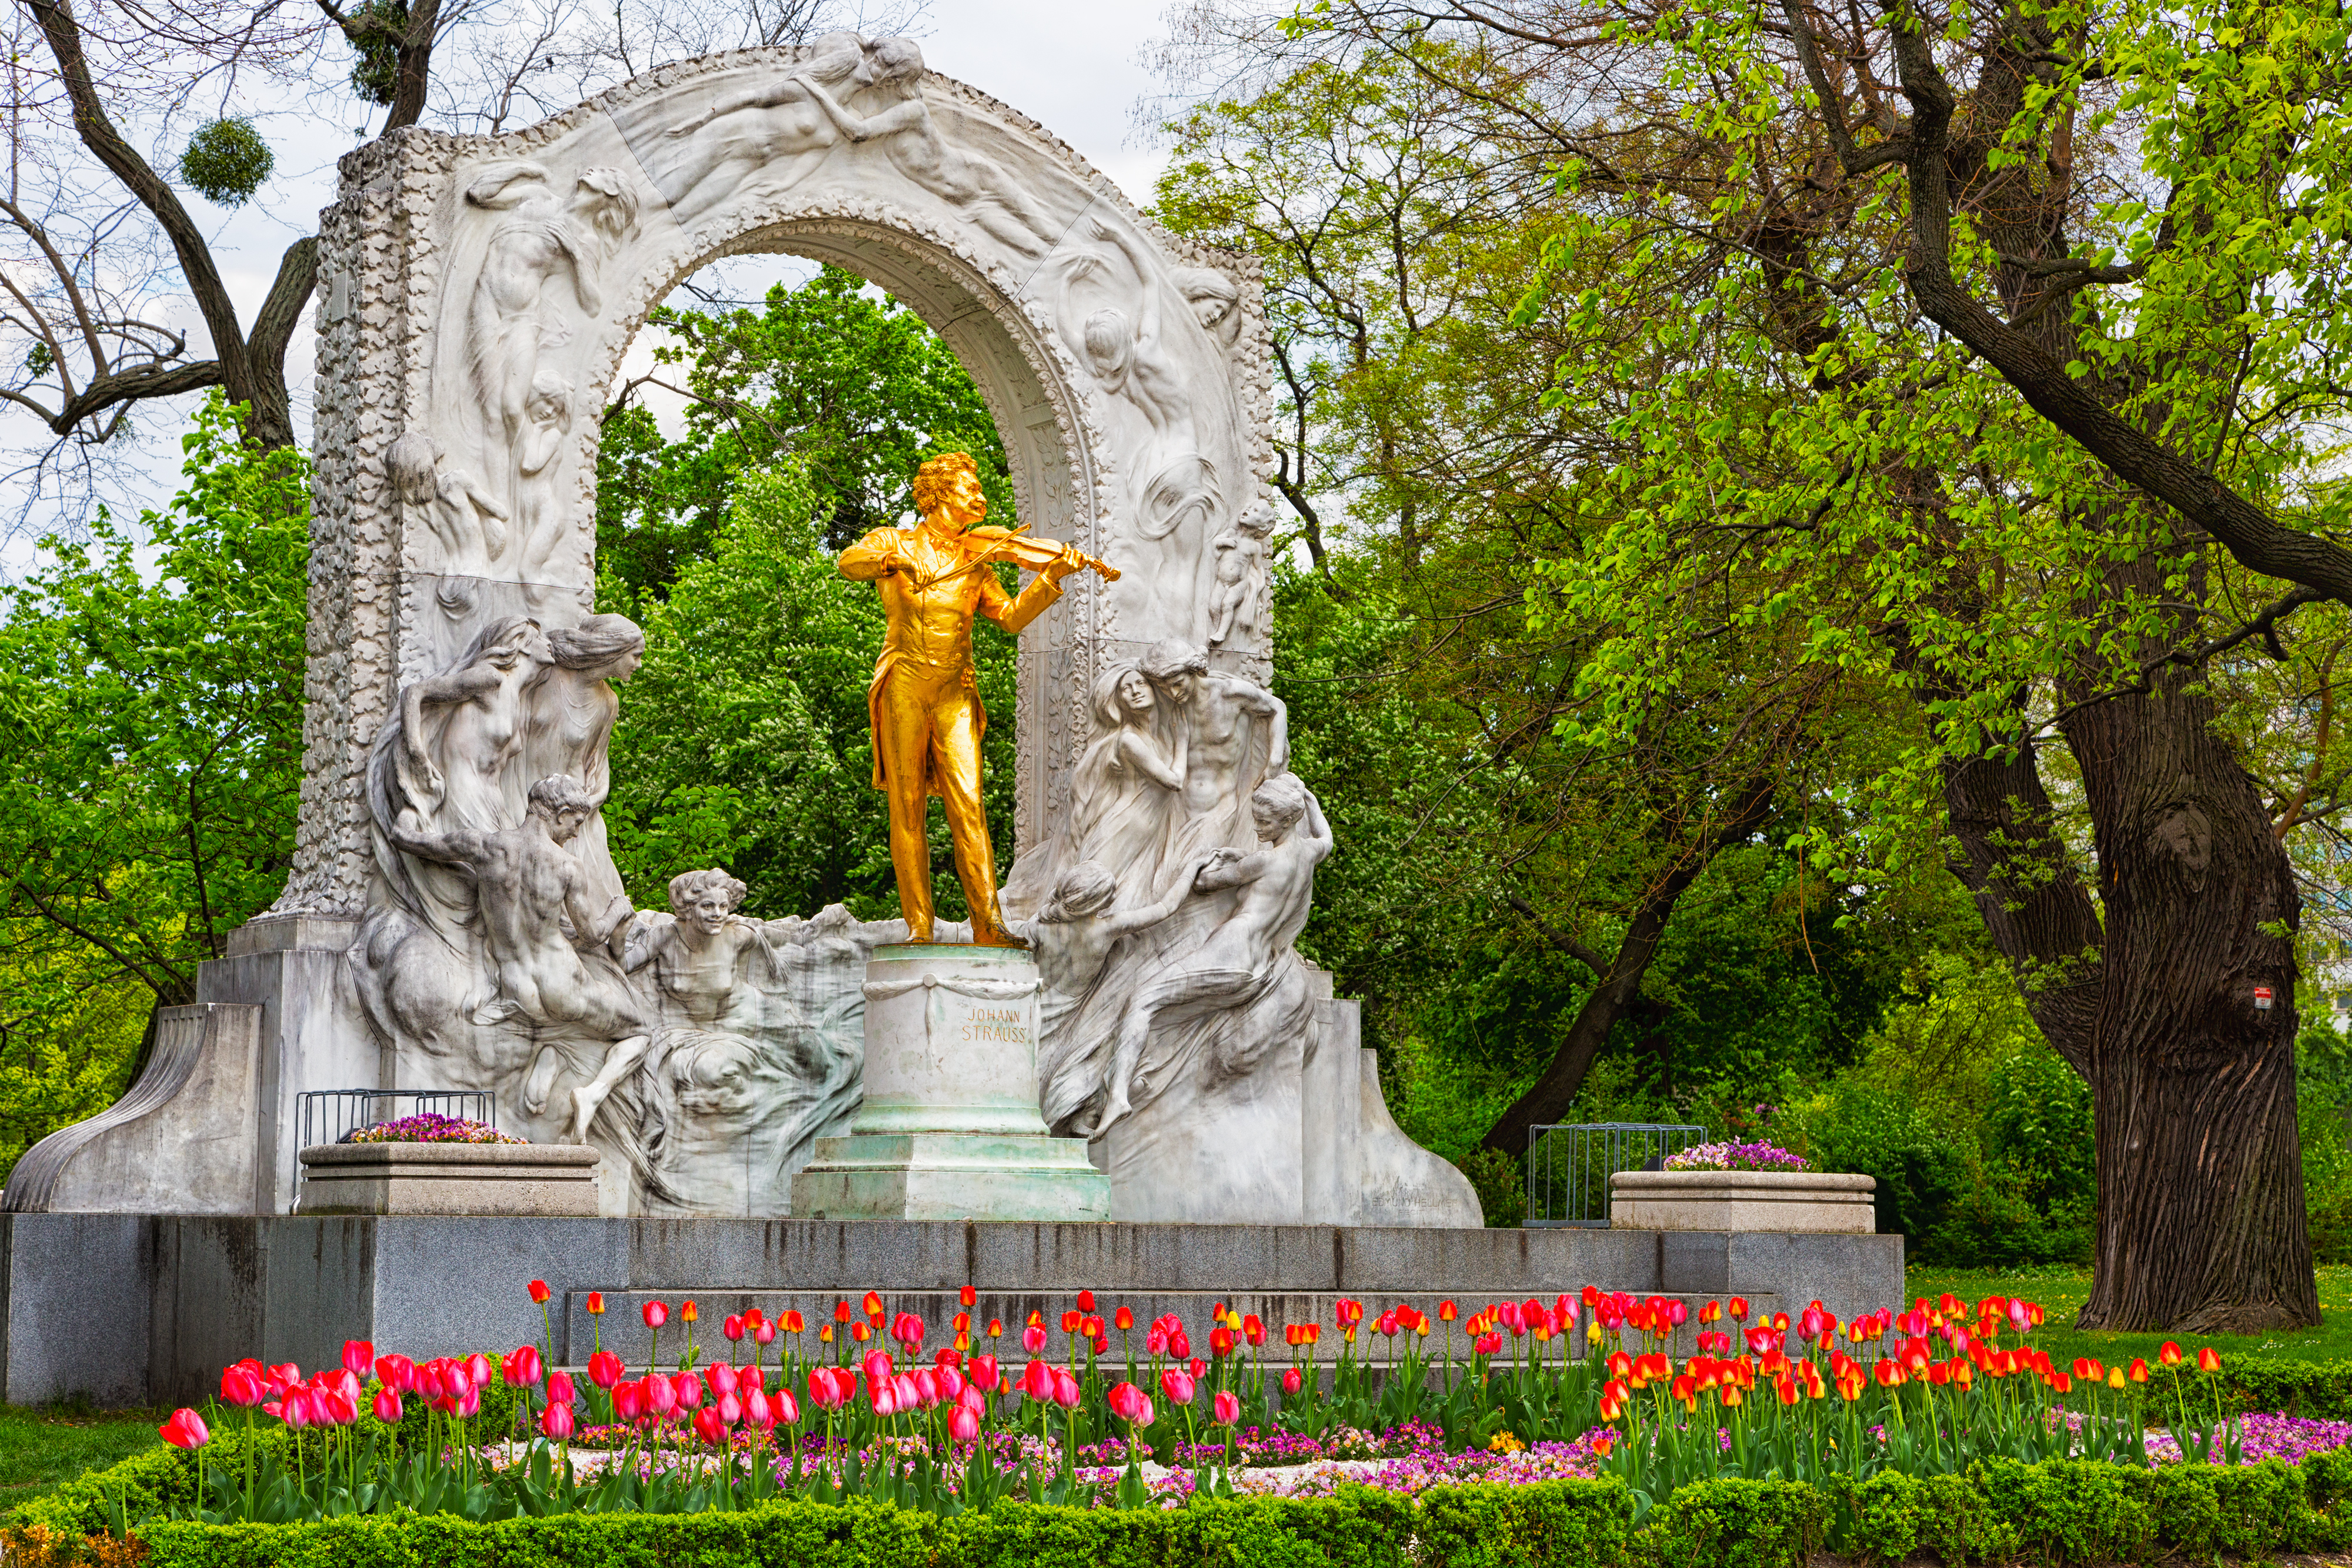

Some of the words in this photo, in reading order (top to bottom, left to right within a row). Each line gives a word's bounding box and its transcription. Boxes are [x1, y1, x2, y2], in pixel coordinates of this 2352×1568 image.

[968, 1008, 1020, 1023] JOHANN
[962, 1025, 1025, 1043] STRAUSS
[1372, 1197, 1411, 1207] EDMUND
